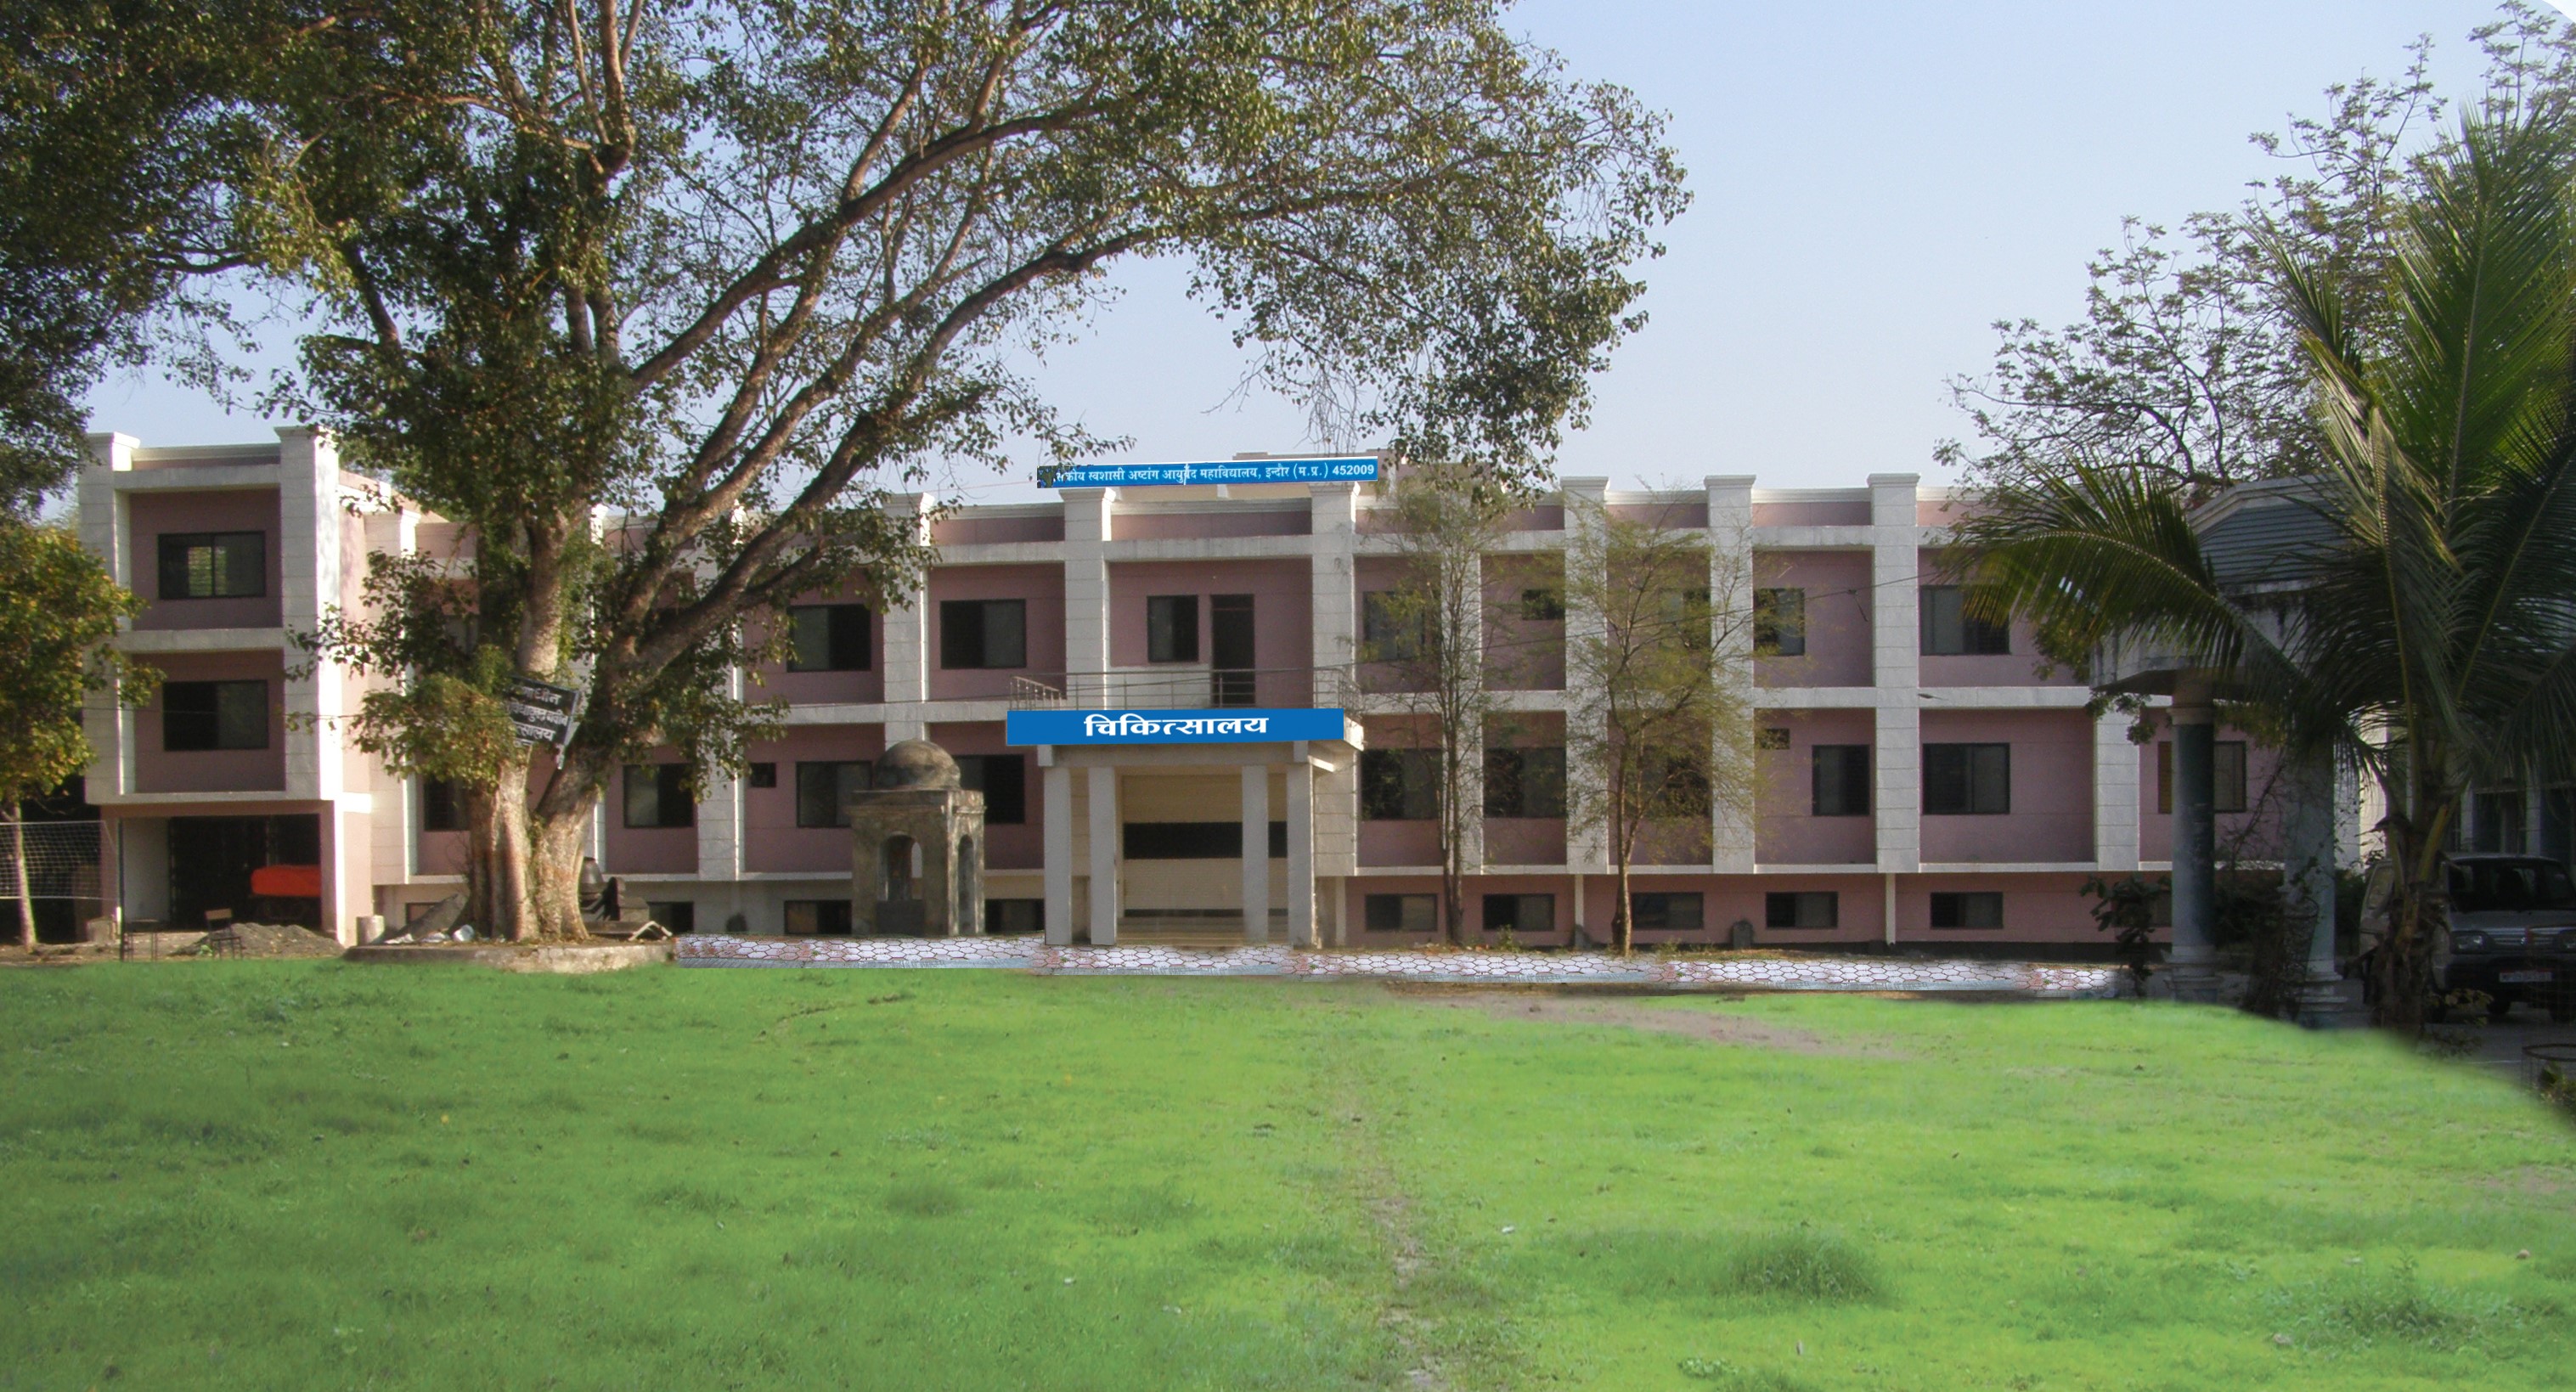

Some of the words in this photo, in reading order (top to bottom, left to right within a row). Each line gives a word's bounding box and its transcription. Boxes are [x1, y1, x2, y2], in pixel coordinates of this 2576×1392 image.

[1088, 467, 1125, 482] स्वशासी
[1128, 467, 1158, 481] अष्टांग
[1265, 463, 1290, 480] इन्दौर
[1332, 464, 1375, 476] 452009
[1084, 713, 1269, 736] चिकित्सालय
